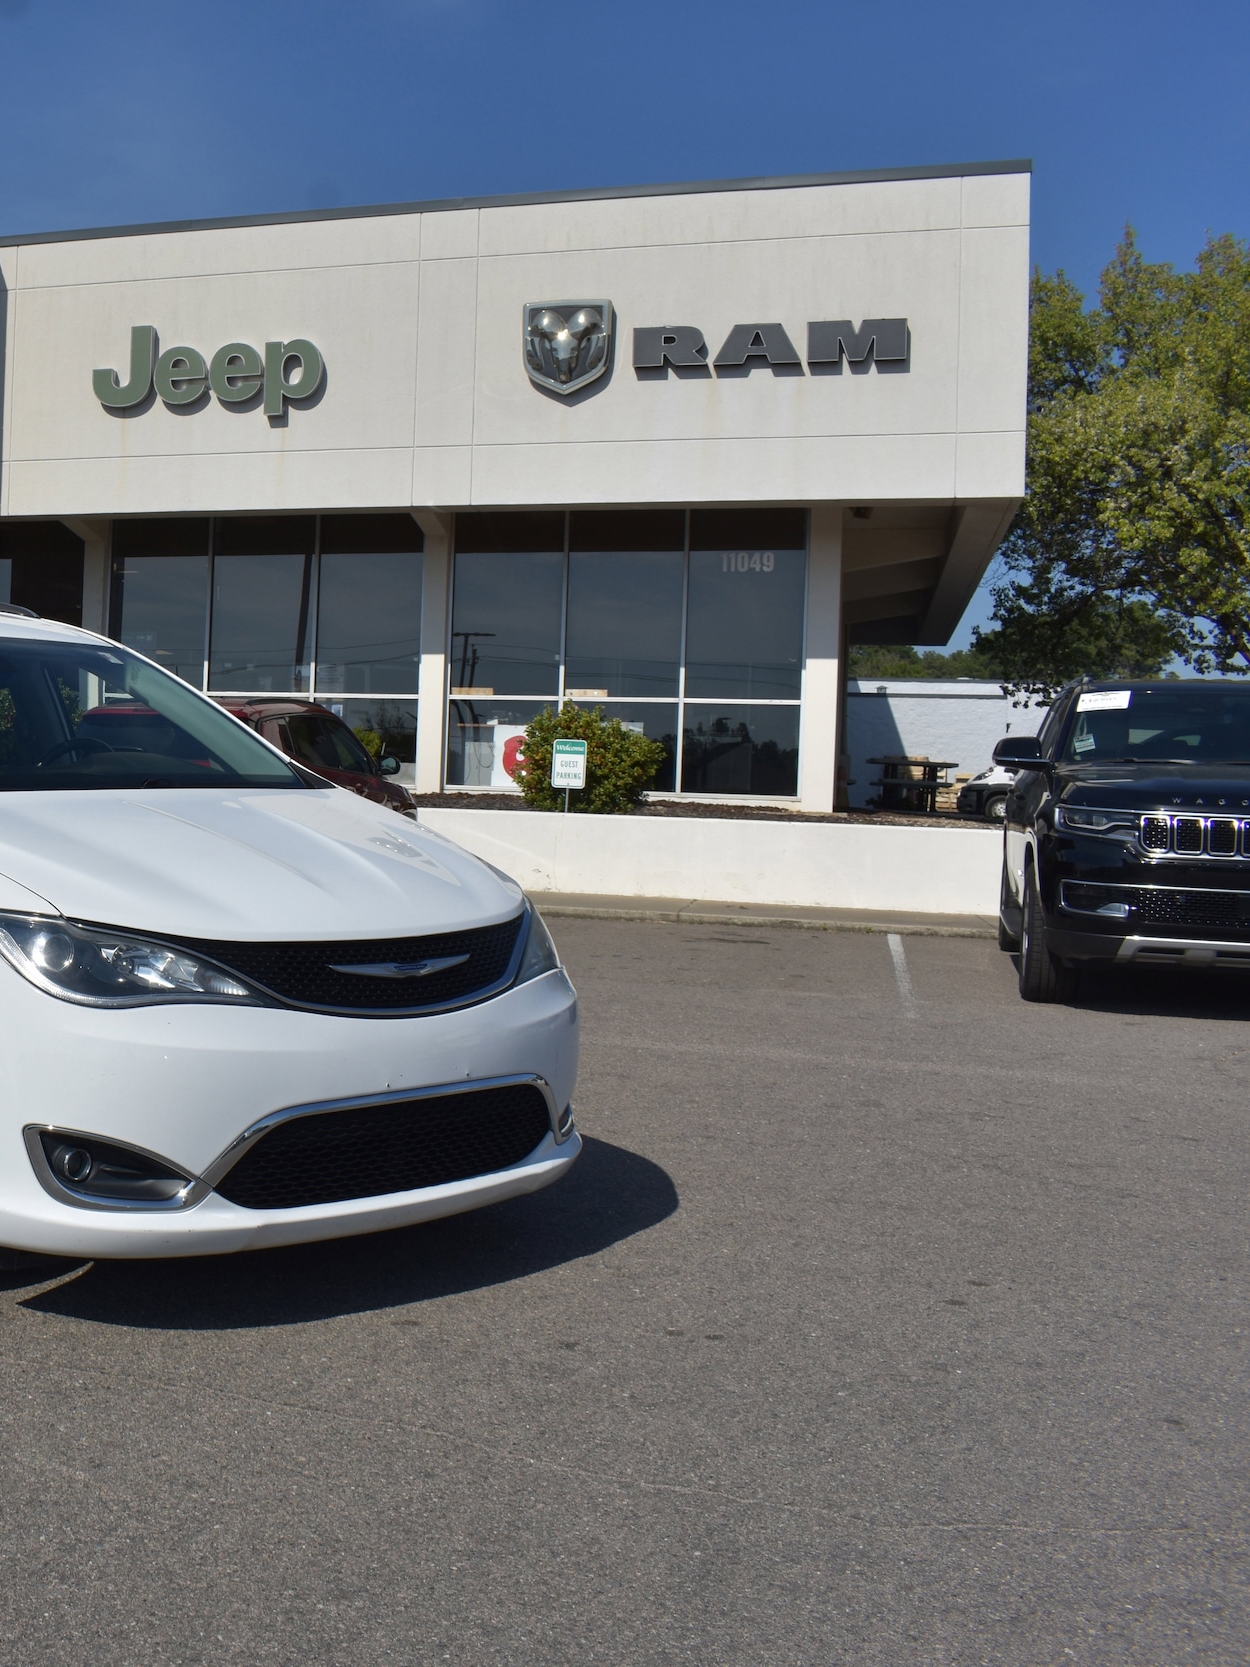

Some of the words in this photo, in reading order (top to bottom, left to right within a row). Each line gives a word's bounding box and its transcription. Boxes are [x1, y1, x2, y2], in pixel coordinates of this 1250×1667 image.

[633, 318, 909, 367] RAM
[92, 325, 324, 416] Jeep
[721, 551, 775, 572] 11049
[556, 743, 585, 752] Welcome
[560, 760, 579, 768] GUEST
[556, 771, 582, 780] PARKING
